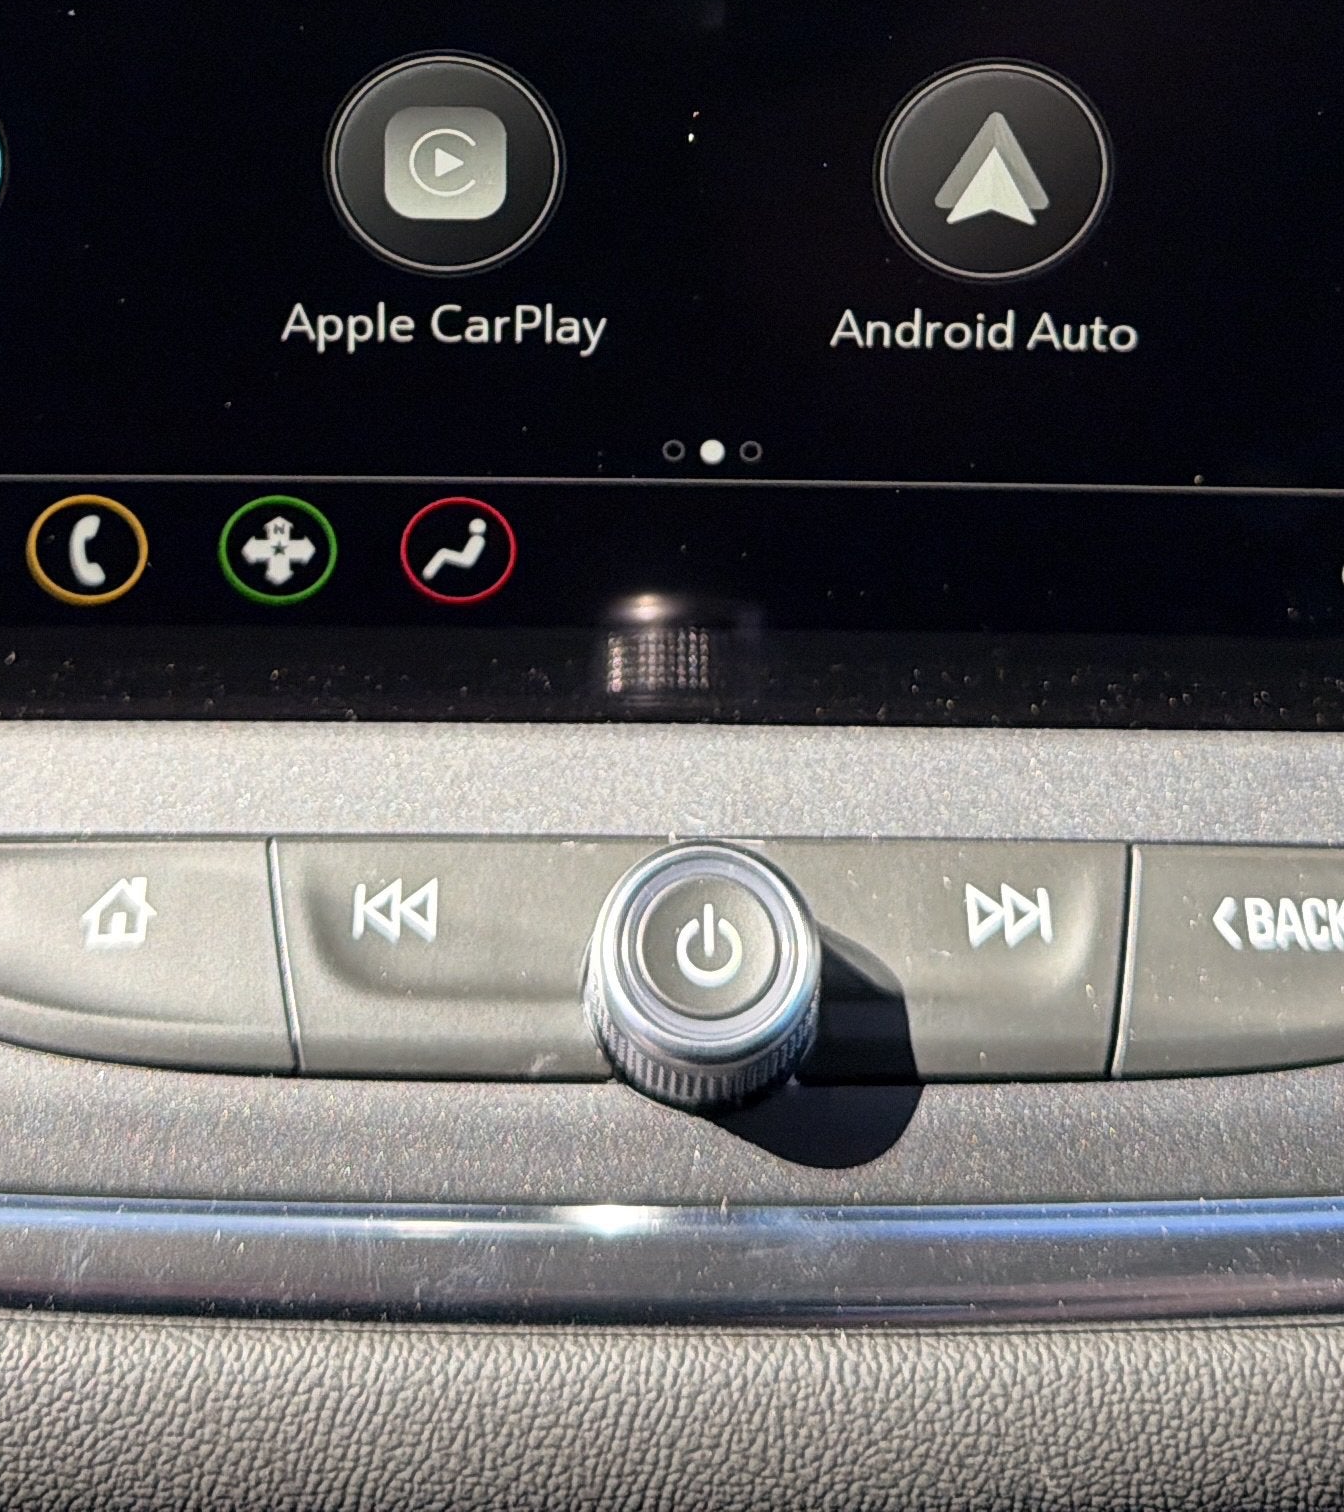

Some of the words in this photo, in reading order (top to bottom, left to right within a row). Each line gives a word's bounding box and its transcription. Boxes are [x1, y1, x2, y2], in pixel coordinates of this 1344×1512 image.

[280, 301, 415, 354] Apple
[430, 302, 607, 357] CarPlay
[829, 307, 1015, 351] Android
[1026, 311, 1138, 353] Auto
